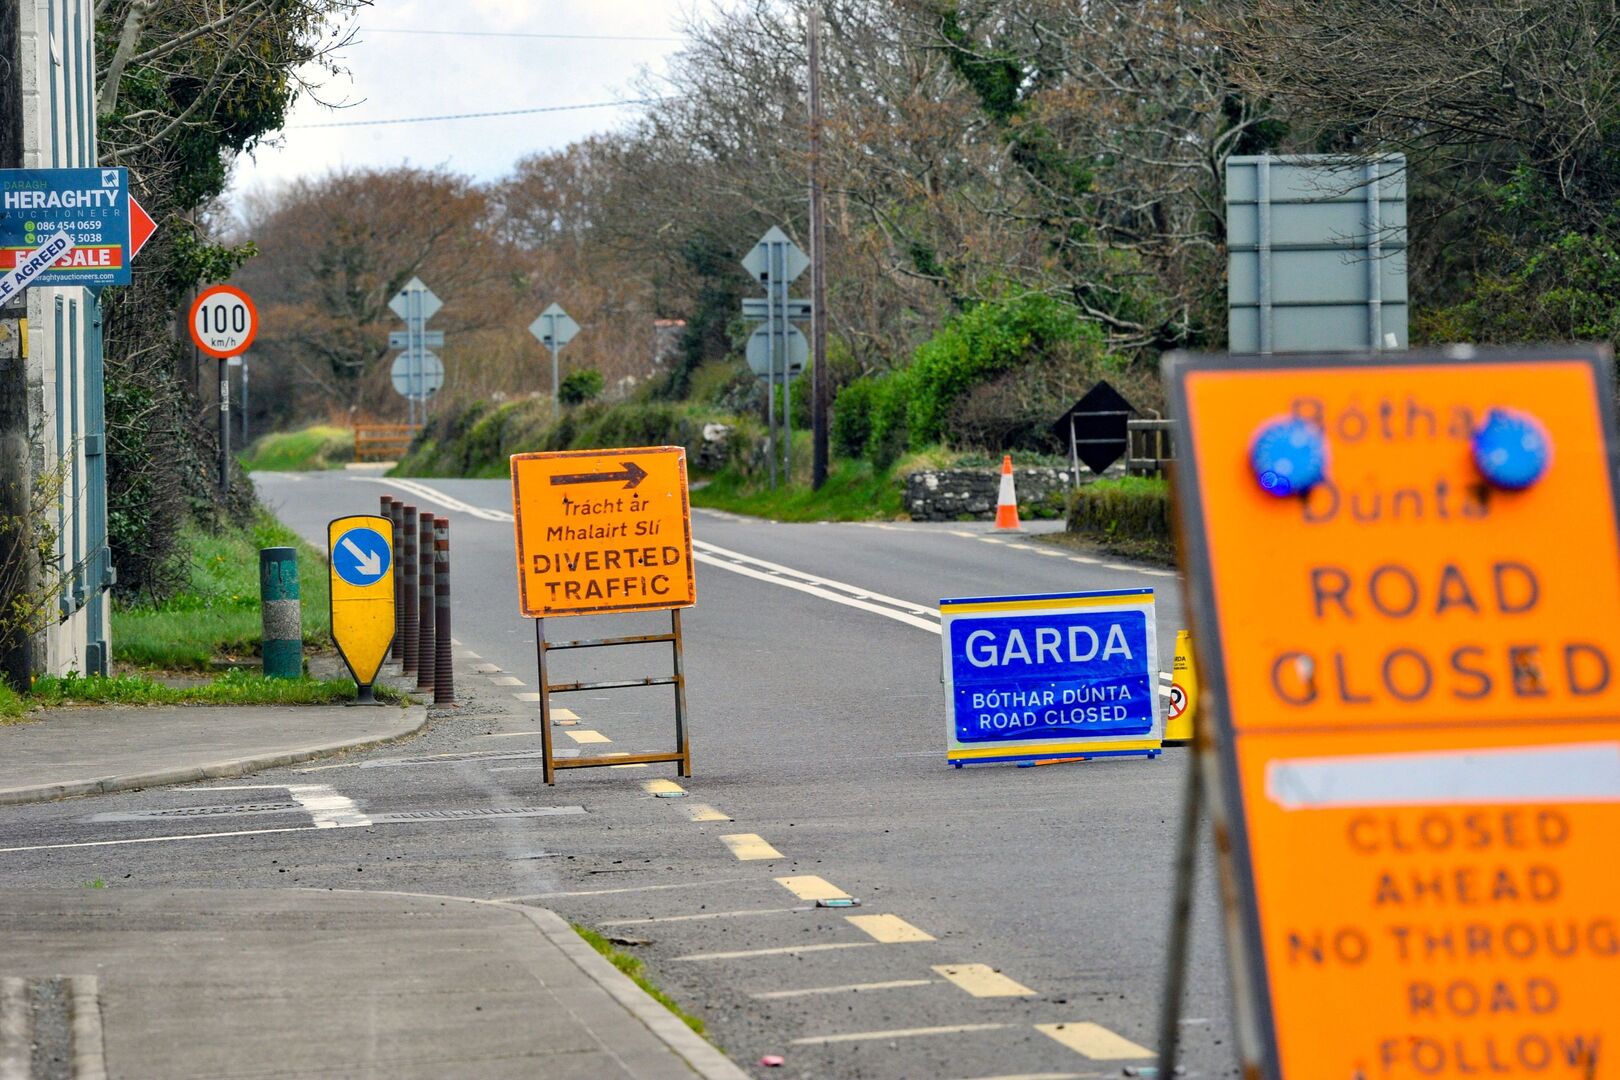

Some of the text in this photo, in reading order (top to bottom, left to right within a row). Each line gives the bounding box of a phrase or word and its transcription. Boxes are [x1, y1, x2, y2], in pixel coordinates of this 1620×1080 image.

[4, 181, 47, 190] DARAGH
[4, 189, 119, 209] HERAGHTY
[5, 209, 120, 219] AUCTIONEER
[36, 220, 102, 231] 086 454 0659
[78, 233, 102, 243] 5038
[15, 238, 66, 285] AGREED
[61, 249, 111, 267] SALE
[34, 273, 114, 282] eraghtyauctioneers.com
[201, 304, 245, 333] 100
[211, 336, 236, 348] km/h
[564, 497, 623, 516] Trácht
[547, 520, 661, 541] Mhalairt Slí
[533, 546, 680, 574] DIVERTED
[545, 575, 670, 601] TRAFFIC
[1309, 560, 1541, 620] ROAD
[965, 623, 1133, 668] GARDA
[1271, 642, 1612, 707] CLOSED
[972, 684, 1132, 710] BÓTHAR DÚNTA
[979, 705, 1128, 730] ROAD CLOSED
[1347, 809, 1571, 854] CLOSED
[1374, 866, 1561, 907] AHEAD
[1288, 928, 1369, 966] NO
[1408, 977, 1560, 1017] ROAD
[1379, 1033, 1602, 1075] FOLLOW
